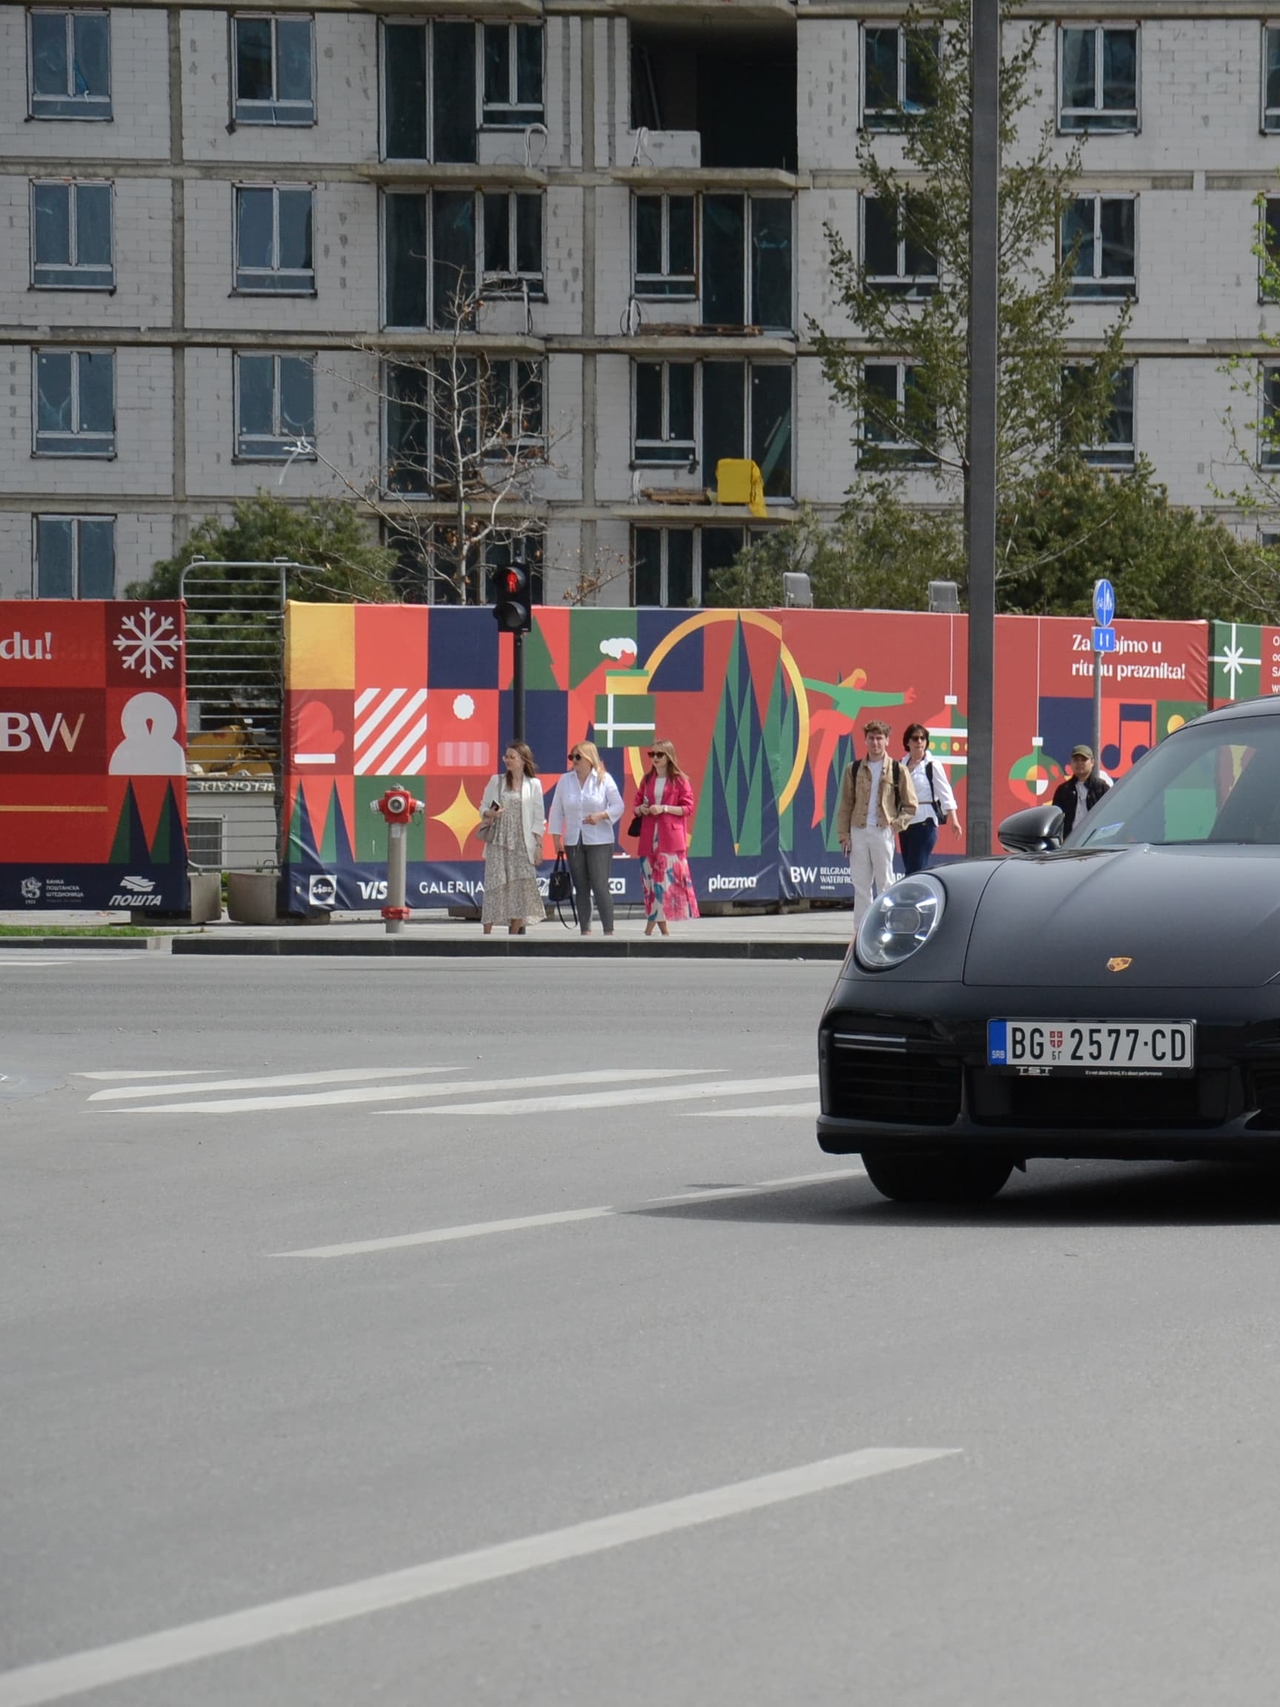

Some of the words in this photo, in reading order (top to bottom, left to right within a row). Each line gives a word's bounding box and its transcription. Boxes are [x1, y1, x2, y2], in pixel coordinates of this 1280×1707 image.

[1152, 641, 1162, 654] u
[1117, 662, 1186, 681] praznika!
[0, 712, 85, 752] BW
[708, 873, 757, 892] plazma
[790, 866, 818, 884] BW
[108, 895, 163, 906] ПОШТА
[1011, 1027, 1044, 1060] BG
[992, 1050, 1005, 1059] SRB
[1051, 1051, 1062, 1061] БГ
